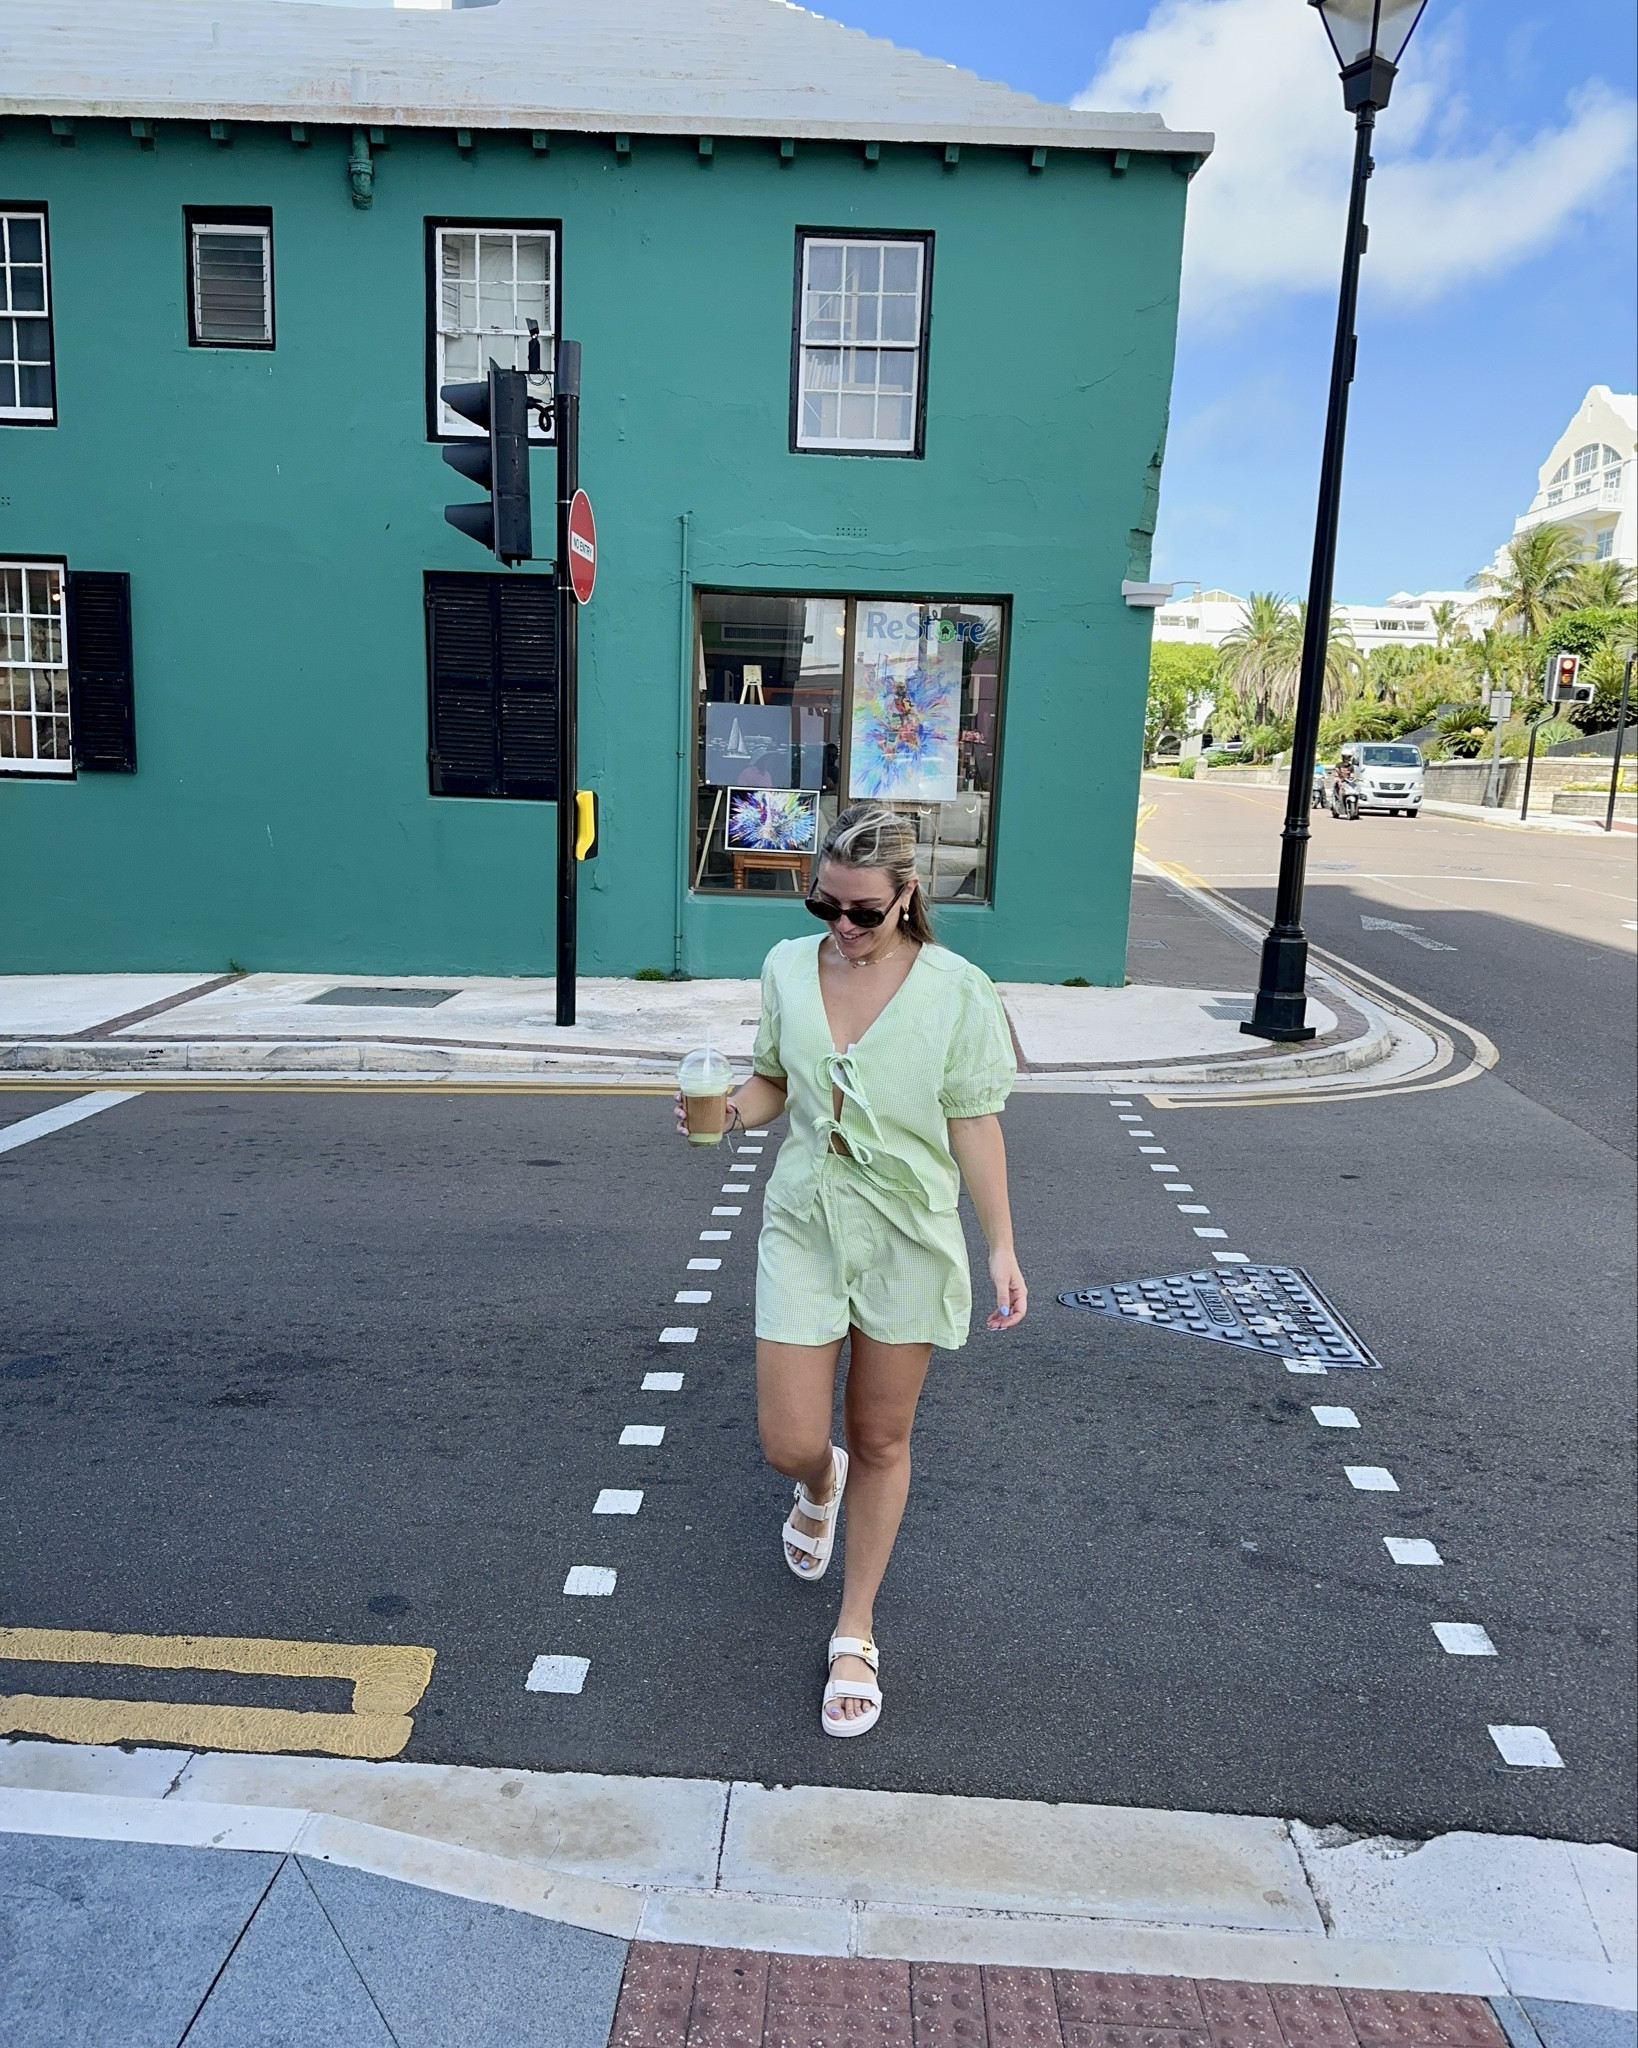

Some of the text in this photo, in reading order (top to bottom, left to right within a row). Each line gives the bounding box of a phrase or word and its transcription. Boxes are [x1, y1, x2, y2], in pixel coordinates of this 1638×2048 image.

[573, 537, 592, 557] NO ENTRY
[867, 611, 986, 643] ReStore
